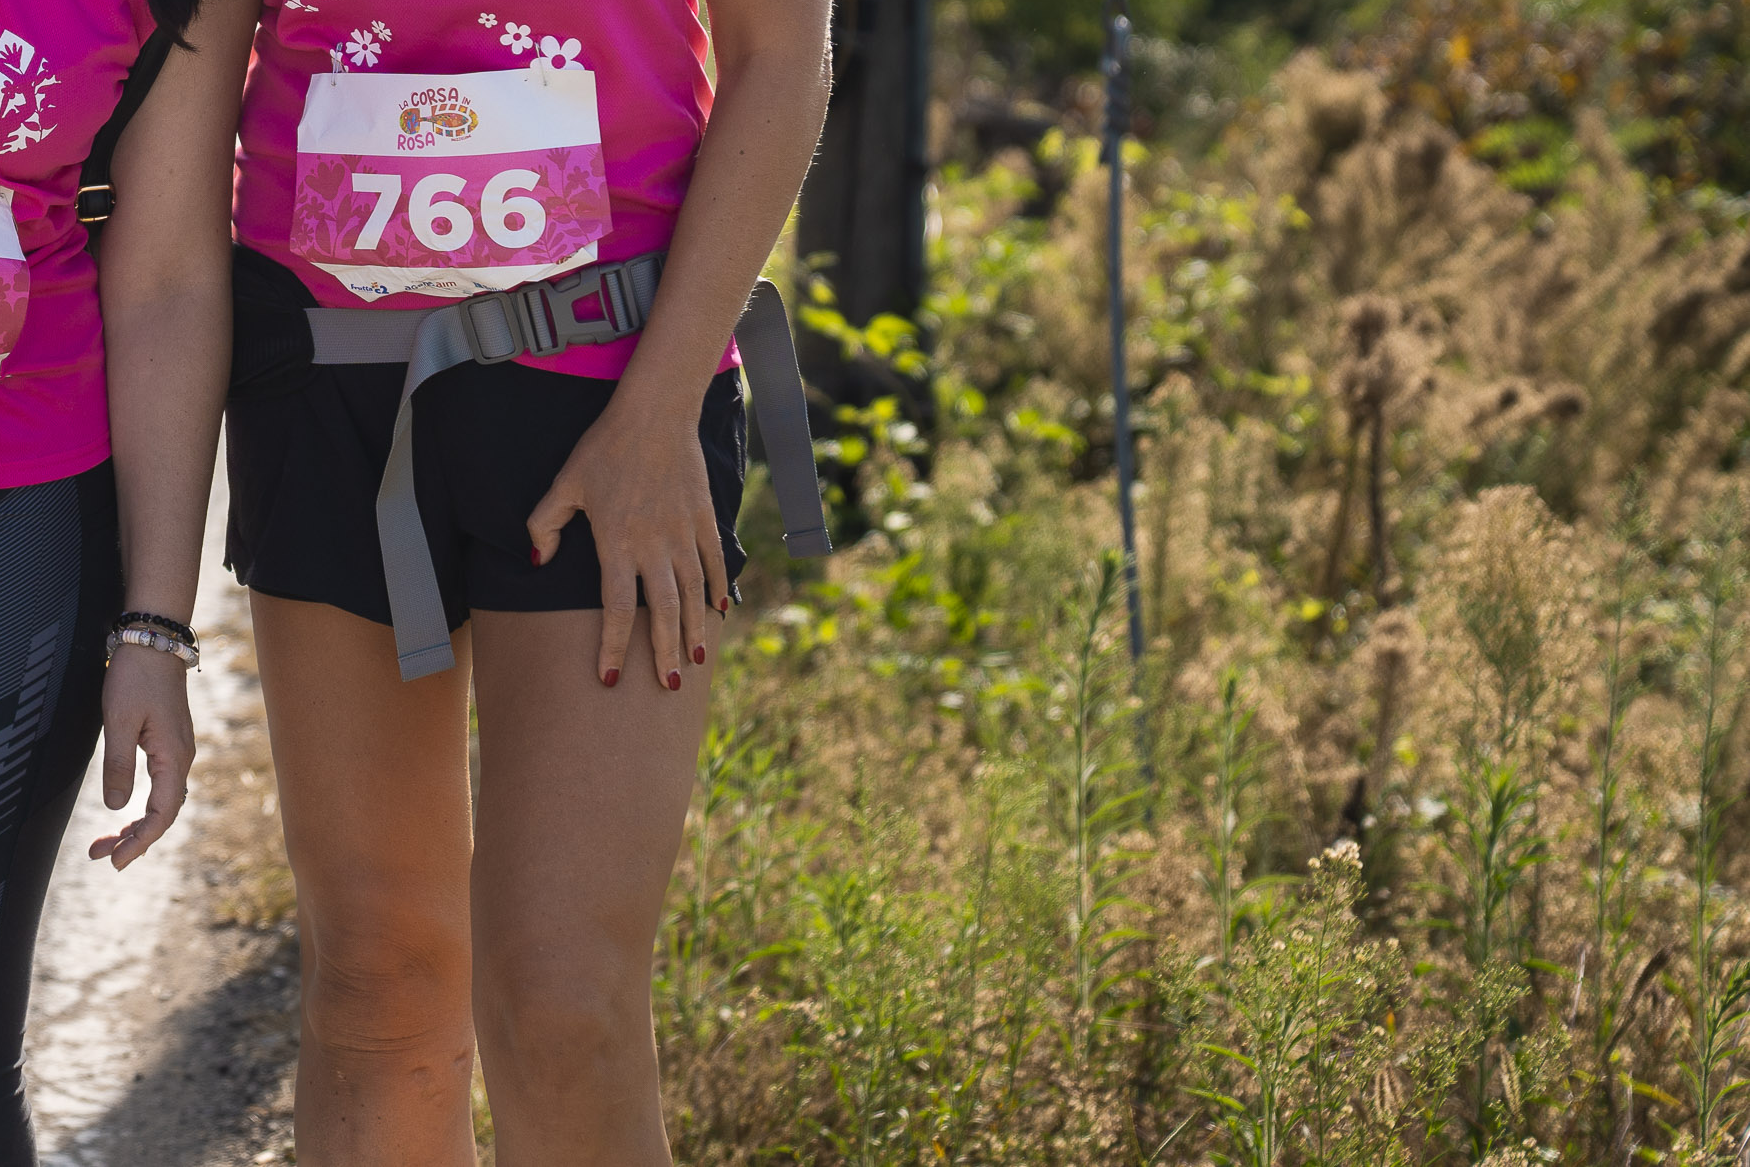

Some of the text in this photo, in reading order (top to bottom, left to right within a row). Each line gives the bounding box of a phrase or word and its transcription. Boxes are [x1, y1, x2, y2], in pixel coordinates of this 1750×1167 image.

[398, 87, 471, 111] LA CORSA IN
[397, 132, 436, 151] ROSA
[351, 168, 547, 252] 766
